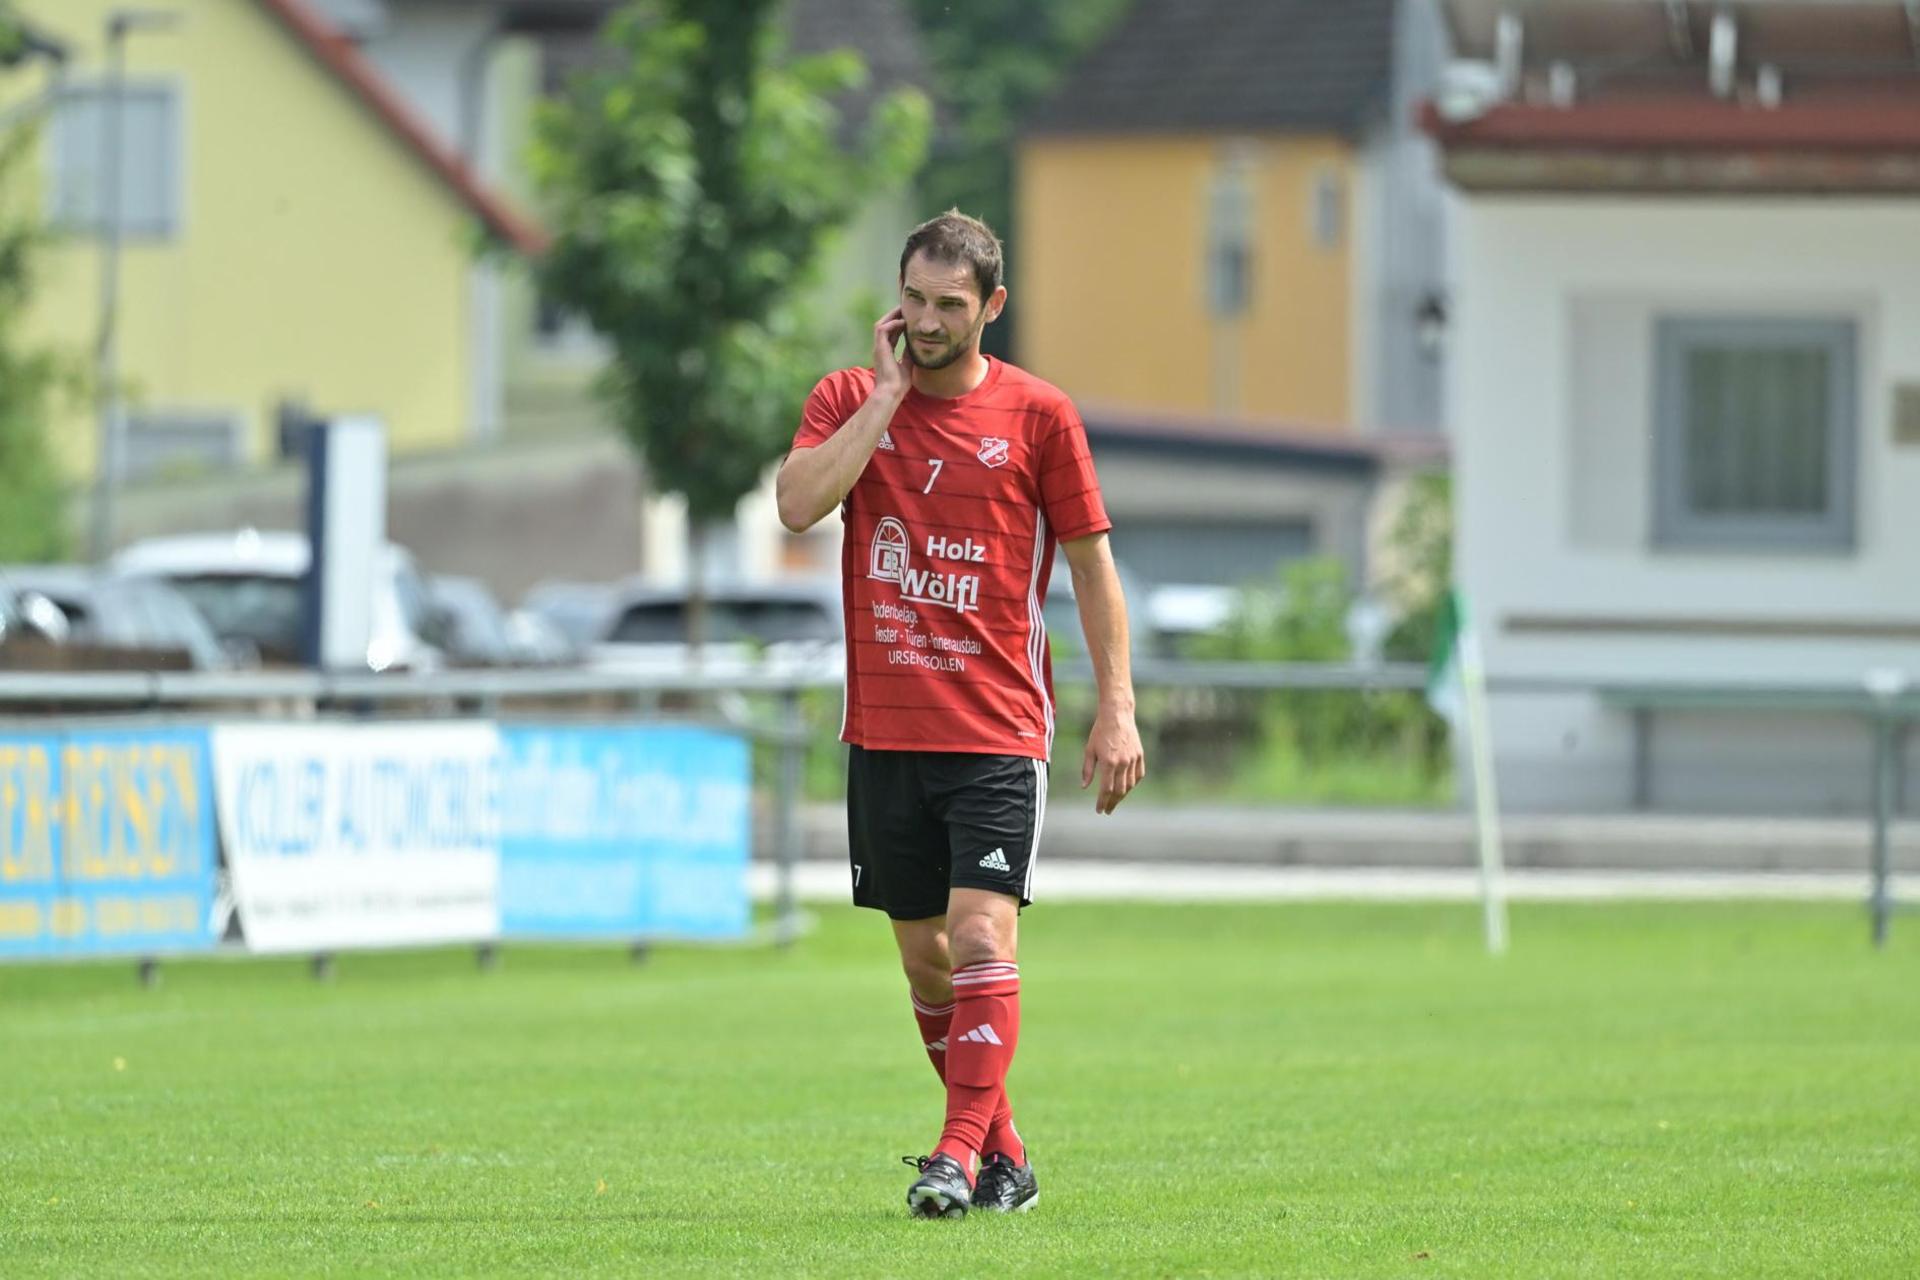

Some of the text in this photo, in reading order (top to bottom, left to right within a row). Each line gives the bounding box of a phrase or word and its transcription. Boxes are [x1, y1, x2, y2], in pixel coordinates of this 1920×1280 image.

[923, 459, 944, 494] 7
[926, 535, 986, 562] Holz
[898, 567, 979, 614] Wölfl
[905, 629, 927, 649] Türen
[888, 650, 965, 672] URSENSOLLEN
[854, 864, 862, 887] 7
[979, 859, 1010, 872] adidas
